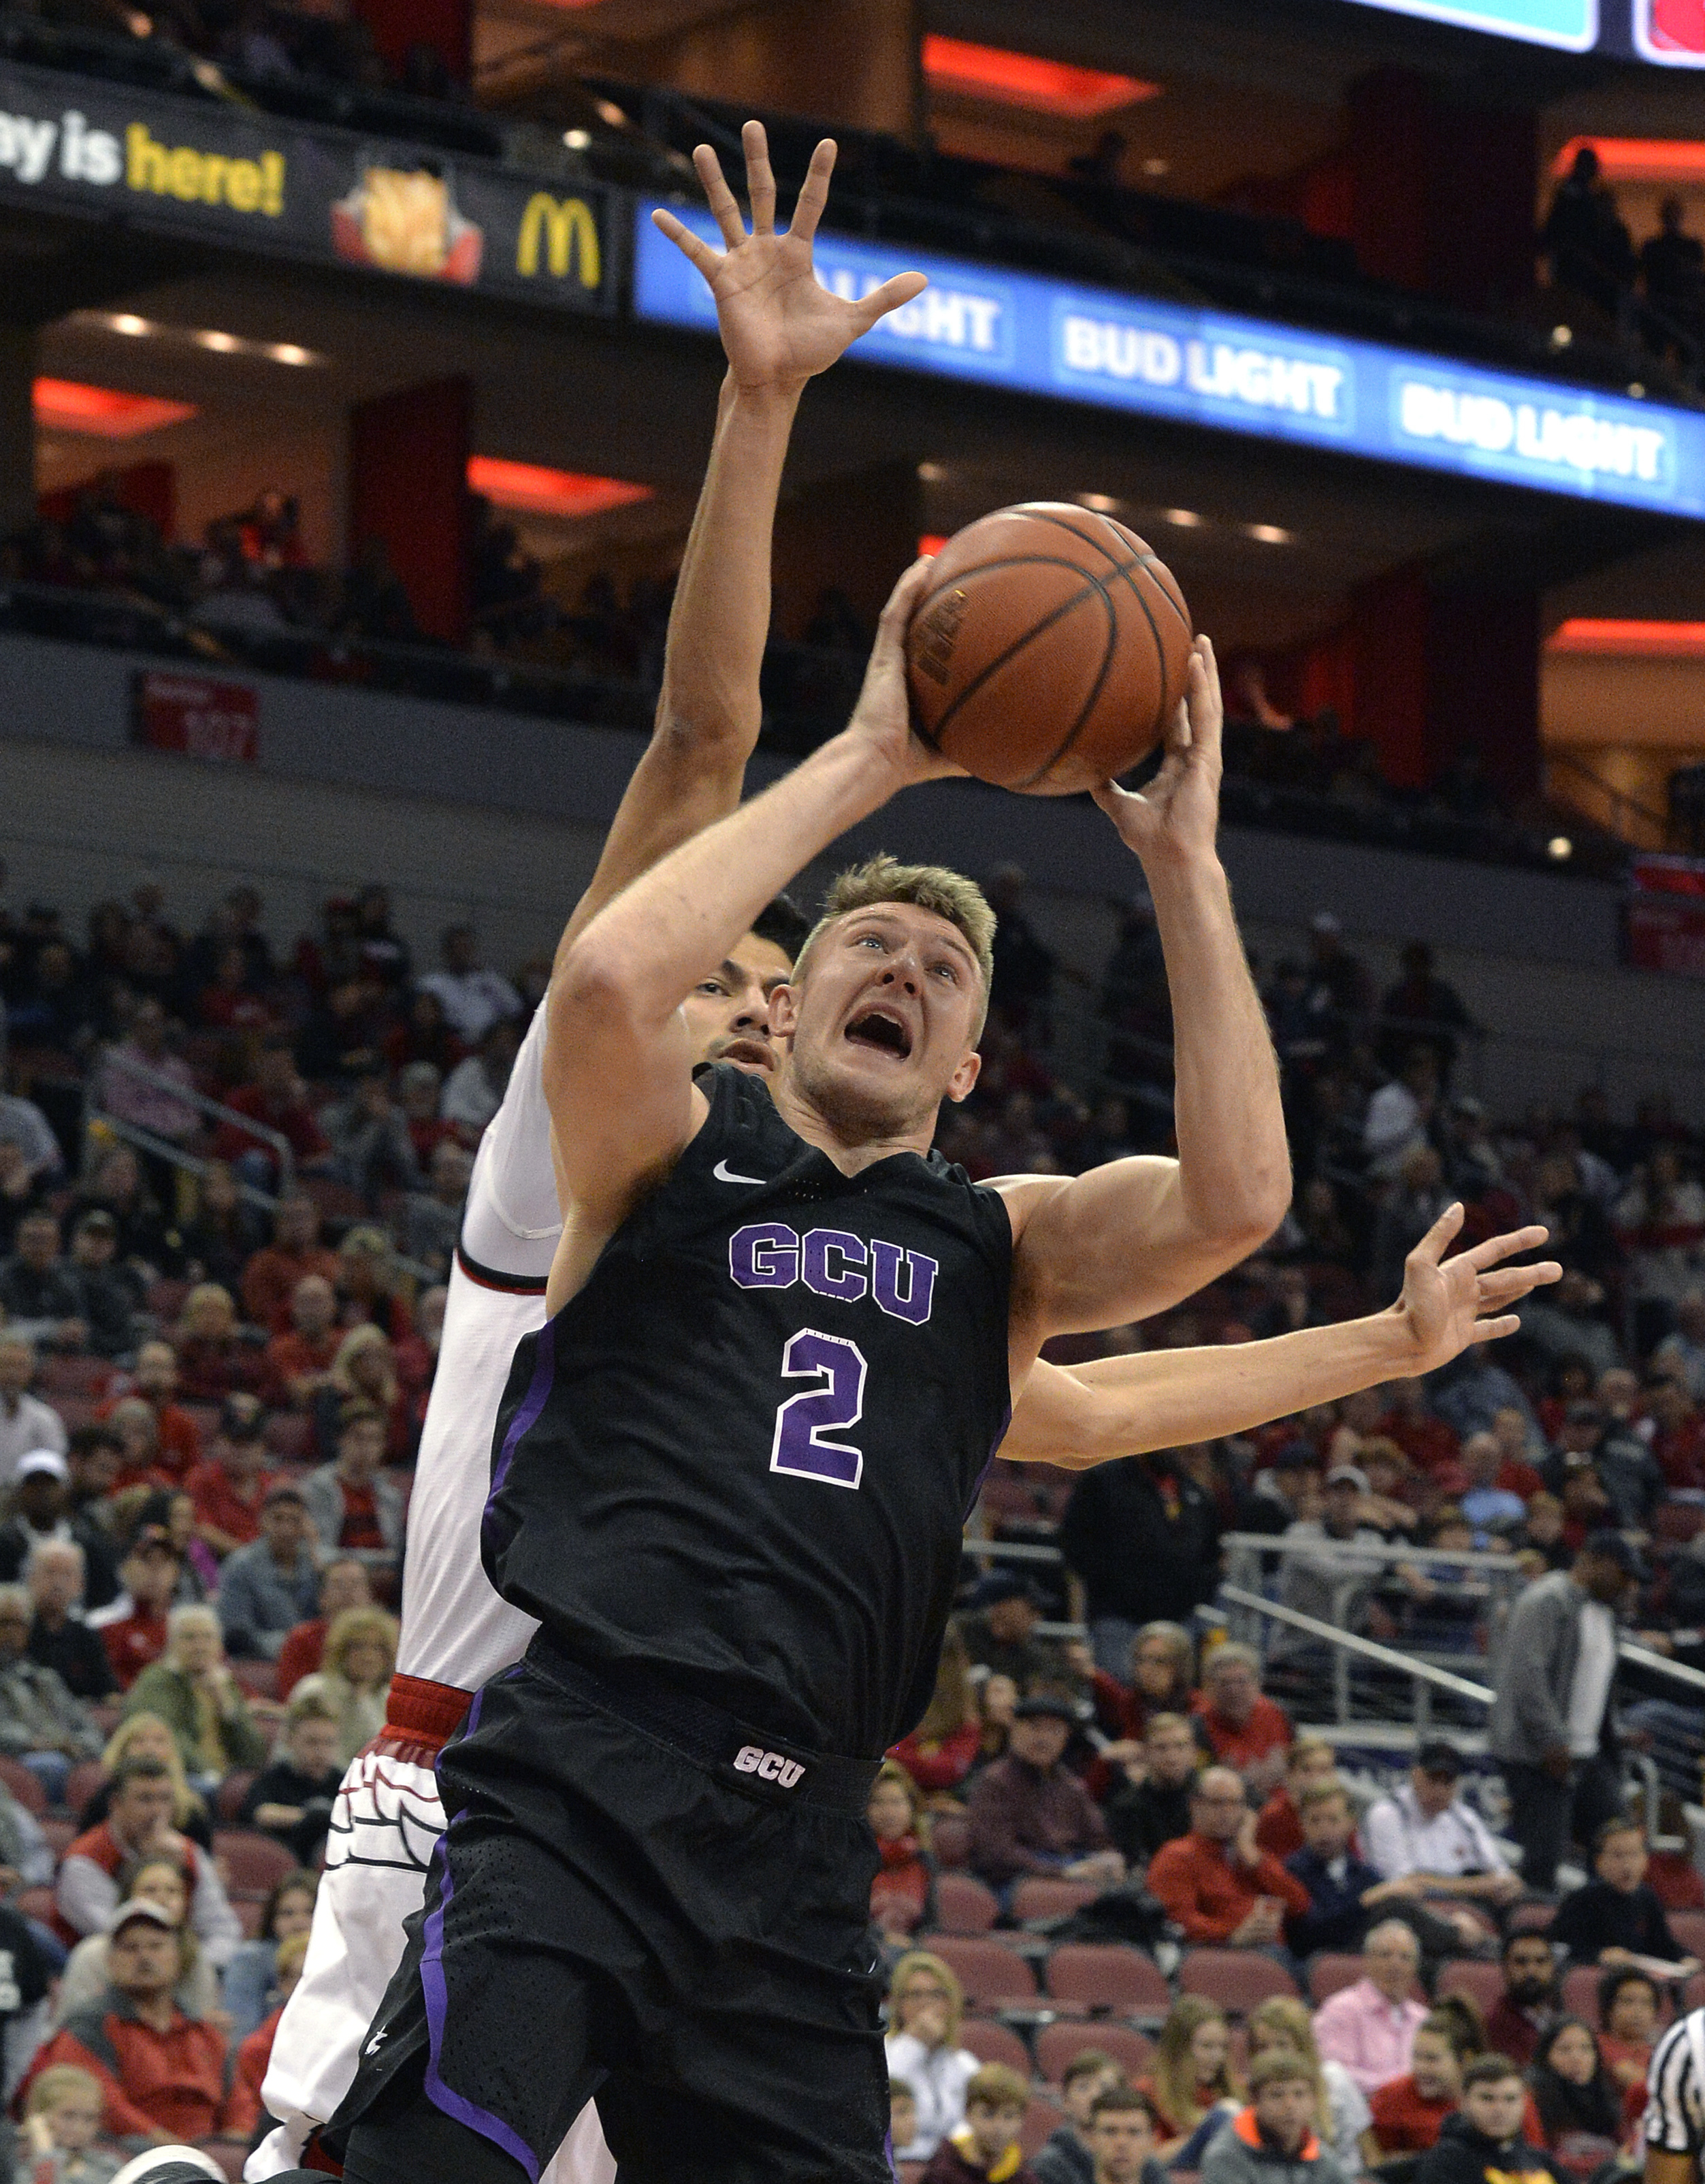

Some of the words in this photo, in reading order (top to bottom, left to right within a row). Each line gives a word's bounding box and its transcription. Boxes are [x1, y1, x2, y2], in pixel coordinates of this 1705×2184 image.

[60, 109, 124, 186] is
[125, 122, 286, 217] here!
[1063, 314, 1181, 387] BUD
[1186, 339, 1343, 419] LIGHT
[1402, 382, 1514, 451] BUD
[1515, 404, 1664, 481] LIGHT
[729, 1223, 939, 1326] GCU
[769, 1328, 868, 1490] 2
[733, 1746, 806, 1788] GCU
